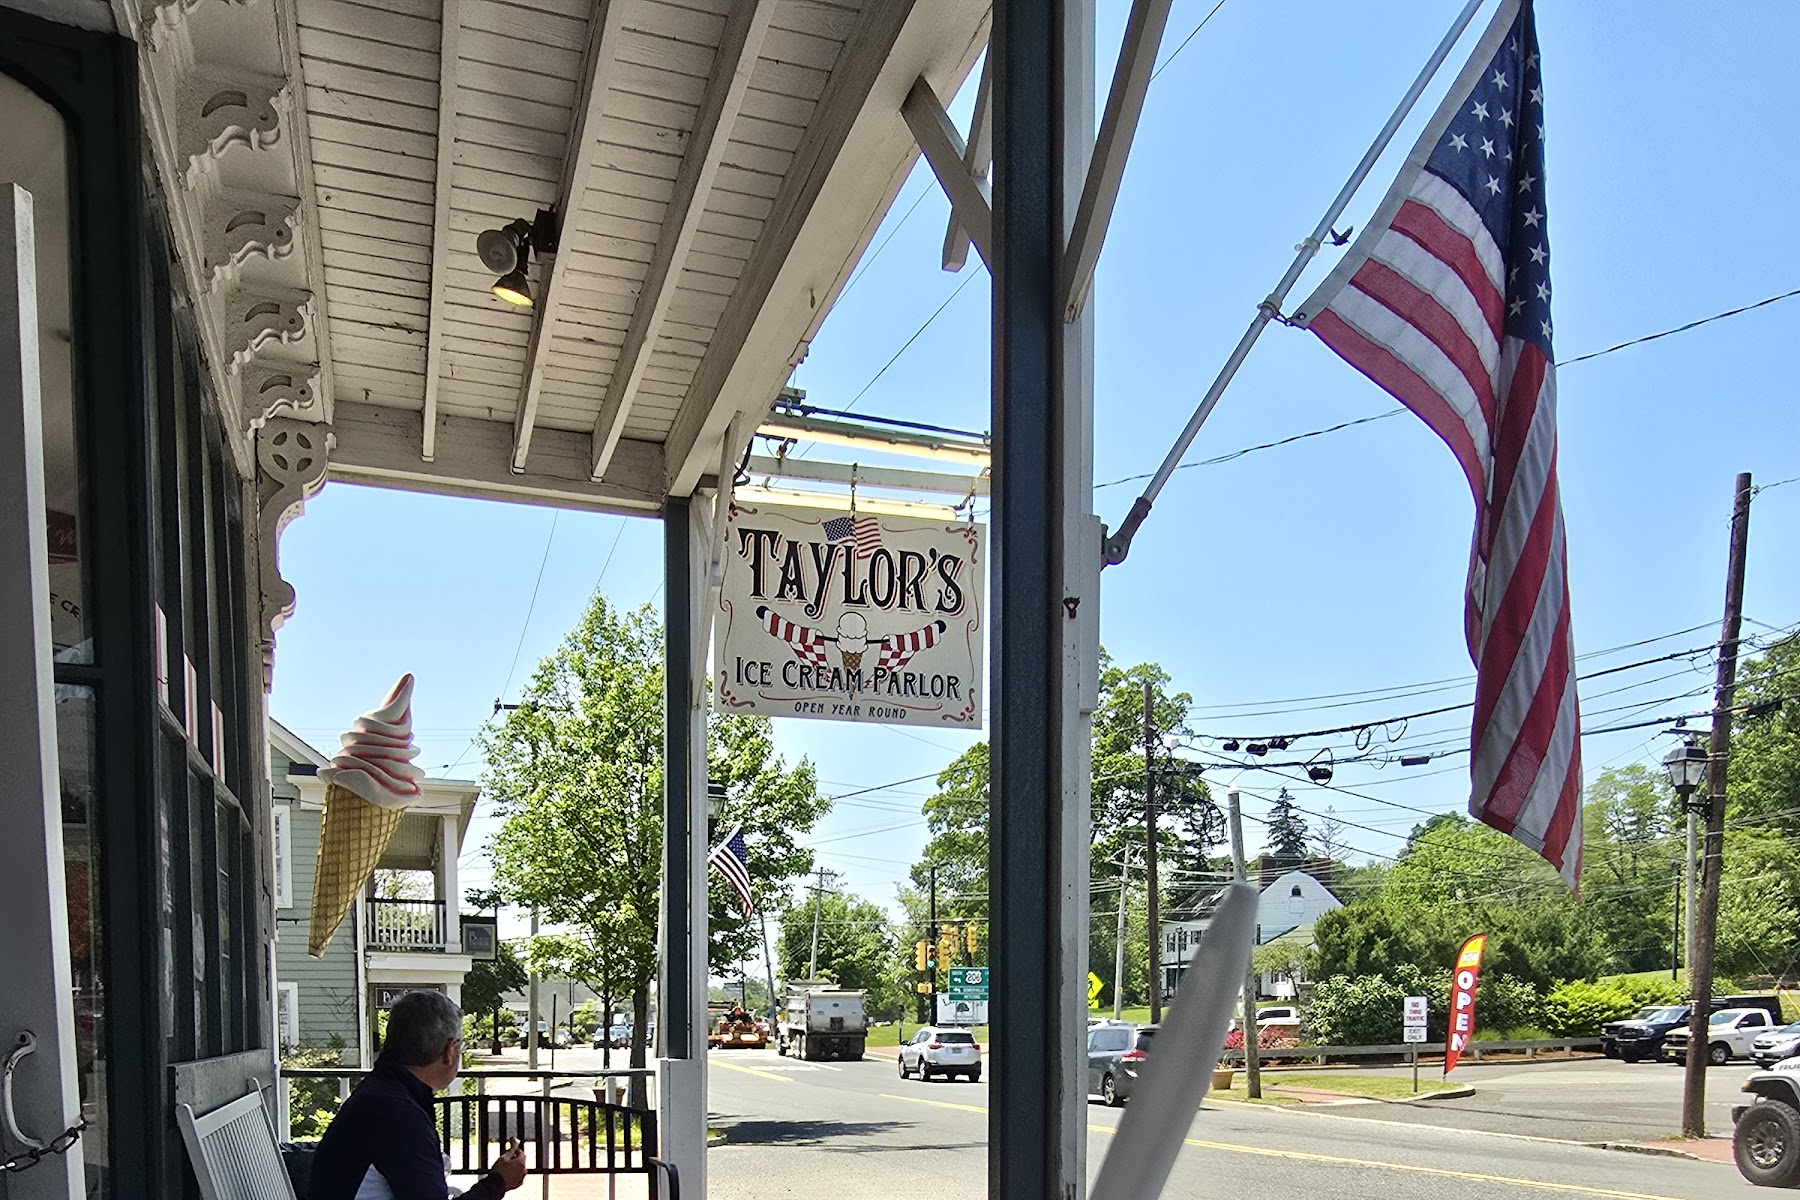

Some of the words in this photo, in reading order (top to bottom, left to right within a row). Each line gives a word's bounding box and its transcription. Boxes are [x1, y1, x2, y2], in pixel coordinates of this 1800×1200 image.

[738, 528, 966, 619] TAYLOR'S
[736, 657, 773, 688] ICE
[782, 660, 863, 694] CREAM
[874, 666, 962, 701] PARLOR
[794, 701, 824, 714] OPEN
[832, 703, 860, 716] YEAR
[869, 706, 907, 719] ROUND
[967, 972, 981, 982] 206
[1450, 970, 1474, 1052] OPEN
